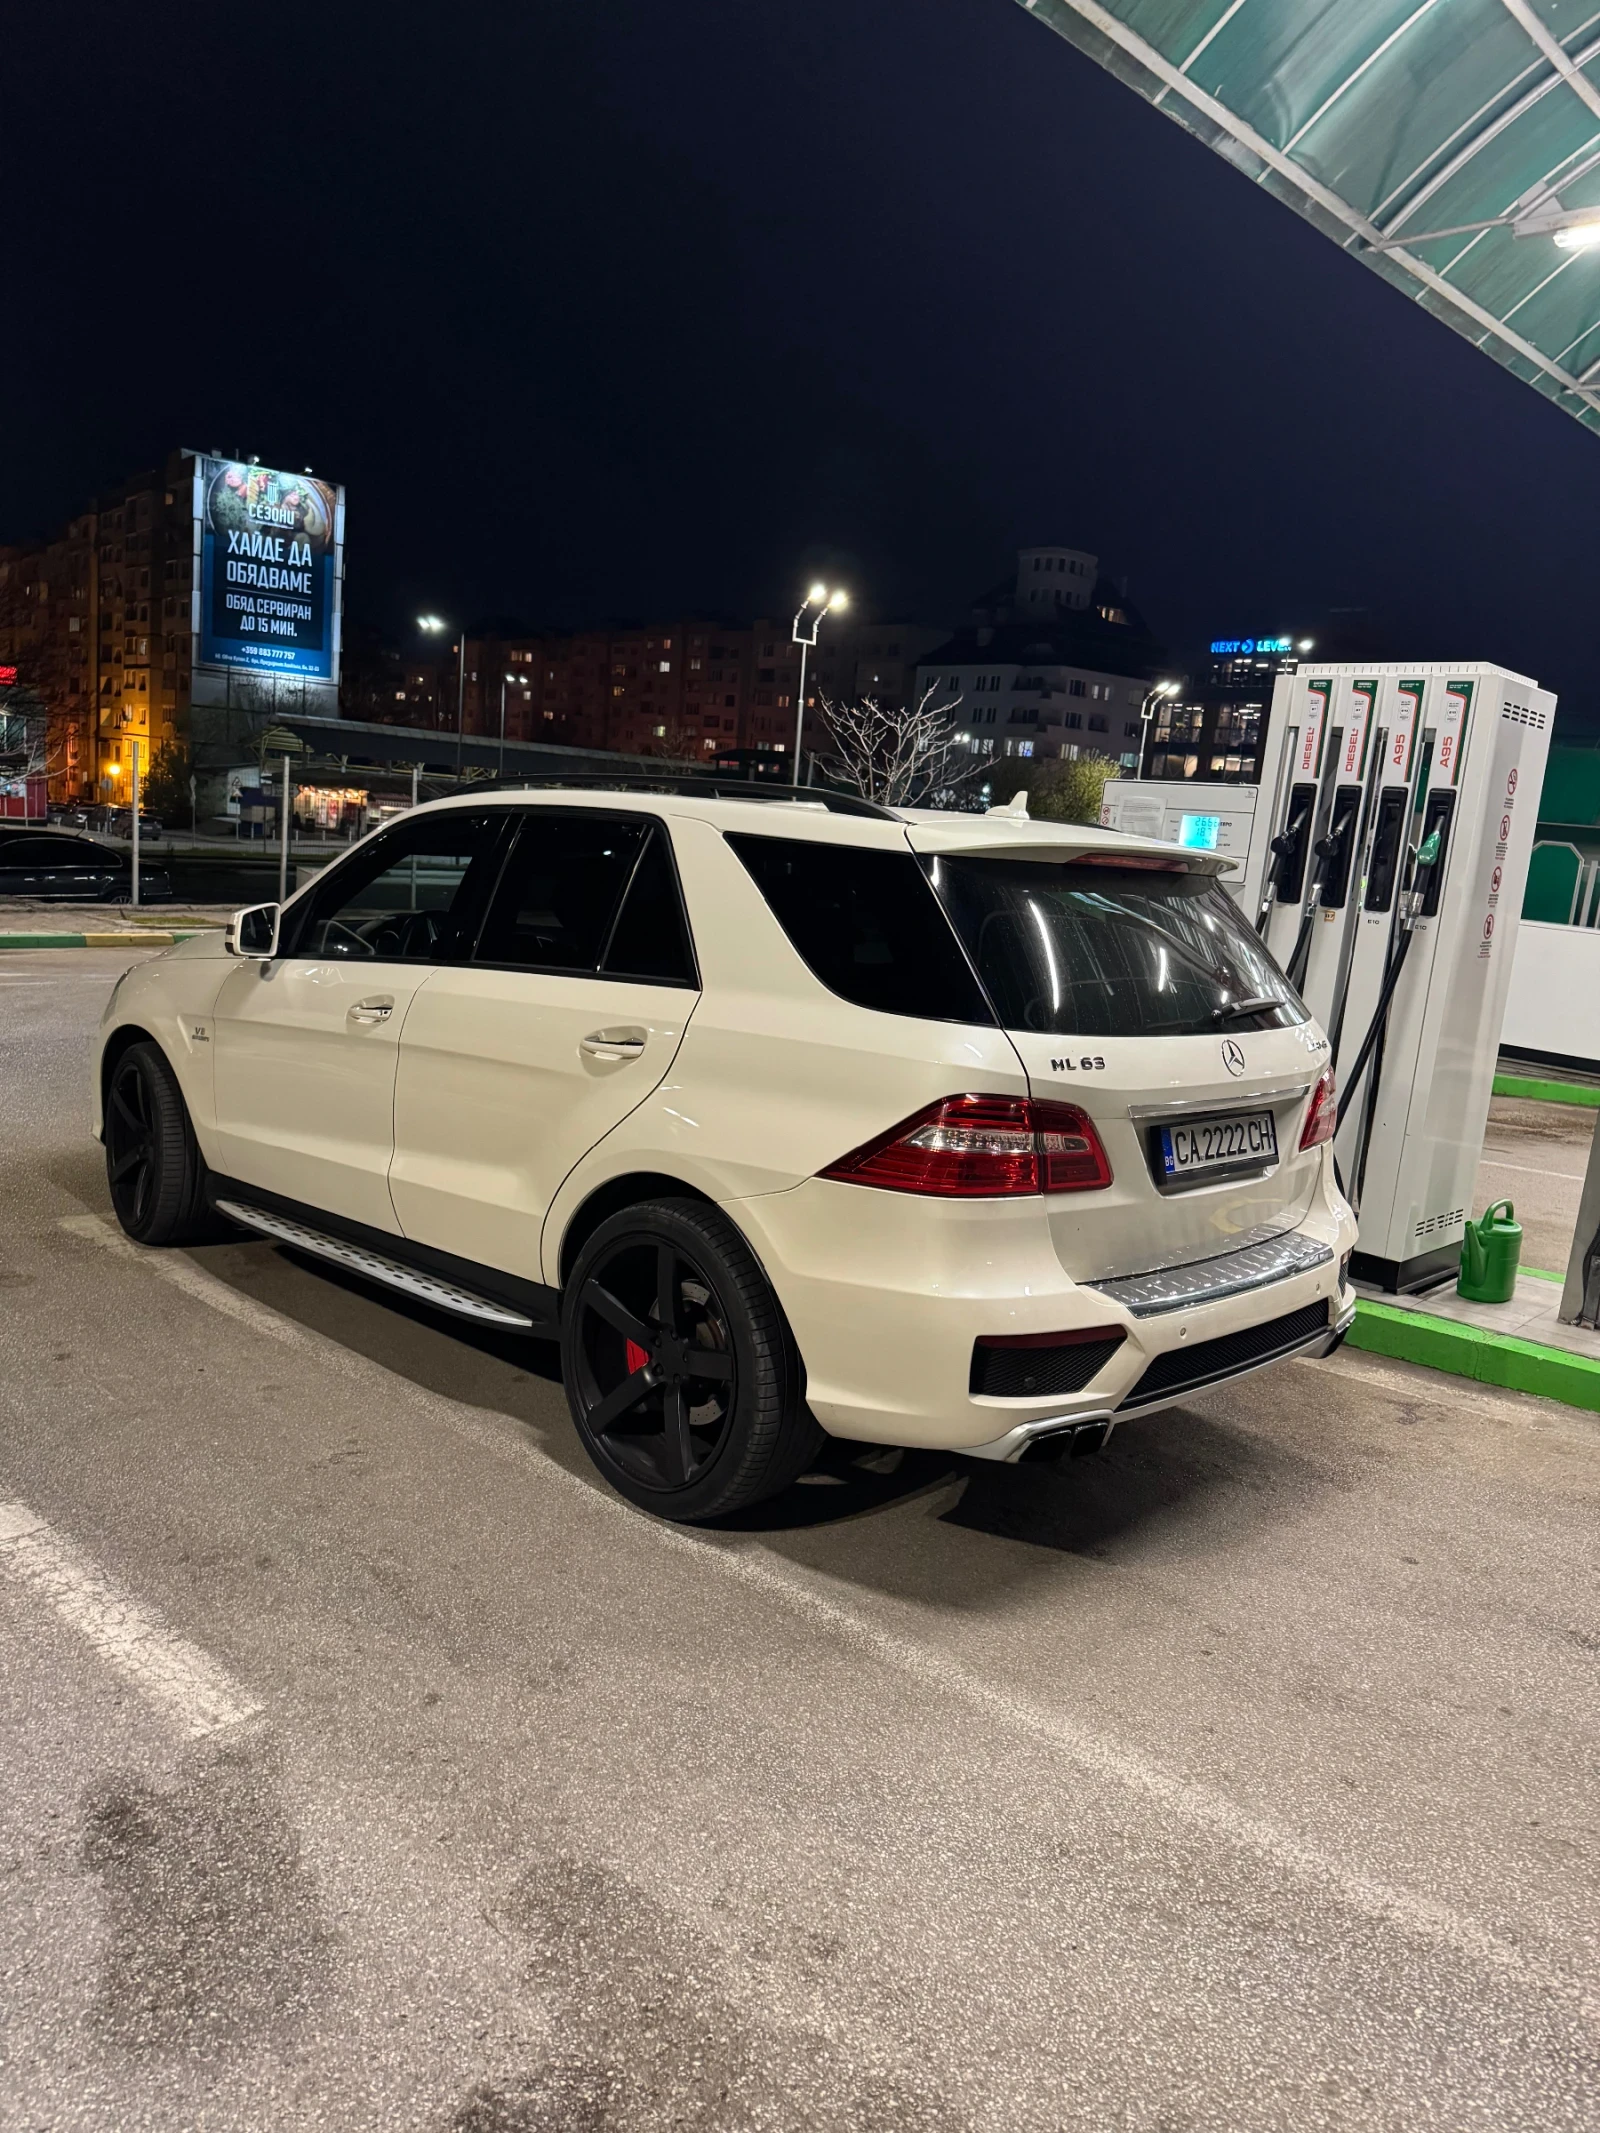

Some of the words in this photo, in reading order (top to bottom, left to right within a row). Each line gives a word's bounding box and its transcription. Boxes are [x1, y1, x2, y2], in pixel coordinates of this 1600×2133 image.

[248, 503, 294, 526] СЕЗОНИ
[227, 529, 285, 563] ХАЙДЕ
[288, 541, 312, 568] ДА
[226, 560, 312, 594] ОБЯДВАМЕ
[226, 594, 255, 613] ОБЯД
[256, 599, 312, 620] СЕРВИРАН
[240, 615, 255, 631] ДО
[257, 617, 268, 632] 15
[270, 620, 298, 637] МИН.
[241, 646, 258, 655] +359
[271, 650, 283, 659] 777
[284, 652, 296, 660] 757
[1210, 641, 1240, 653] NEXT
[1256, 640, 1292, 652] LEVE
[1393, 734, 1405, 765] A95
[1440, 736, 1453, 768] A95
[1051, 1058, 1077, 1071] ML
[1080, 1057, 1105, 1070] 63
[1165, 1156, 1174, 1166] BG
